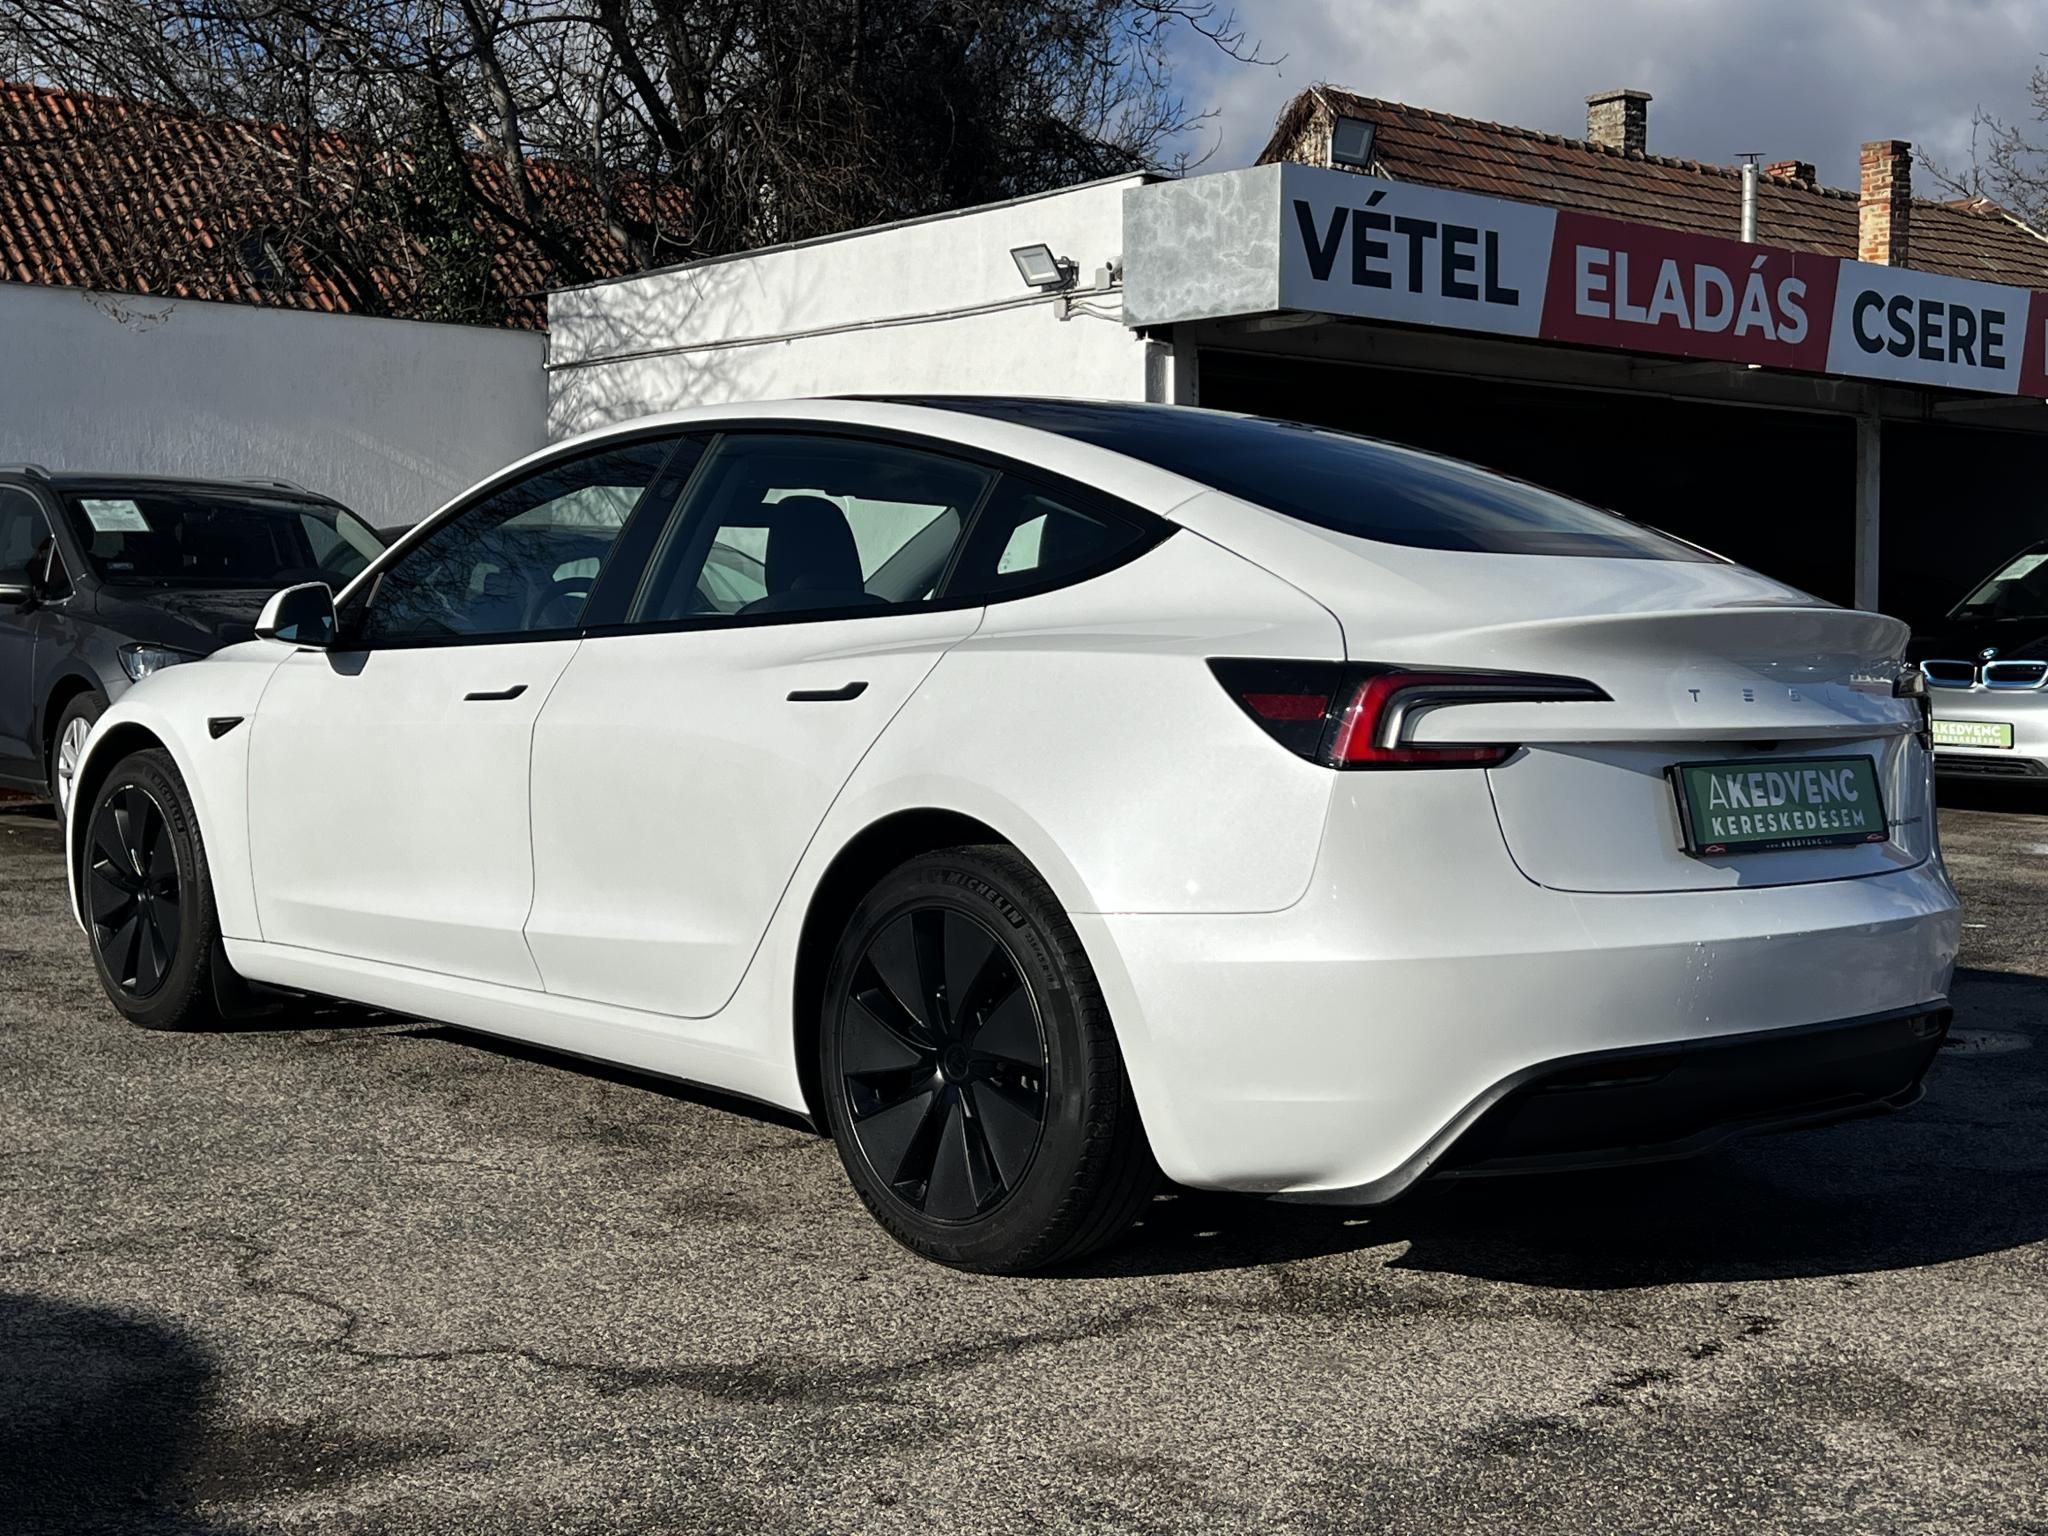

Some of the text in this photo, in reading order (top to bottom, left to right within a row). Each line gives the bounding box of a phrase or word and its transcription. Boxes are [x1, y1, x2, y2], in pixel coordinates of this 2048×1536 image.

[1293, 191, 1519, 307] VÉTEL
[1574, 254, 1809, 344] ELADÁS
[1851, 289, 2007, 370] CSERE
[1709, 768, 1859, 810] AKEDVENC
[1711, 804, 1866, 837] KERESKEDÉSEM
[945, 871, 1023, 924] MICHELIN
